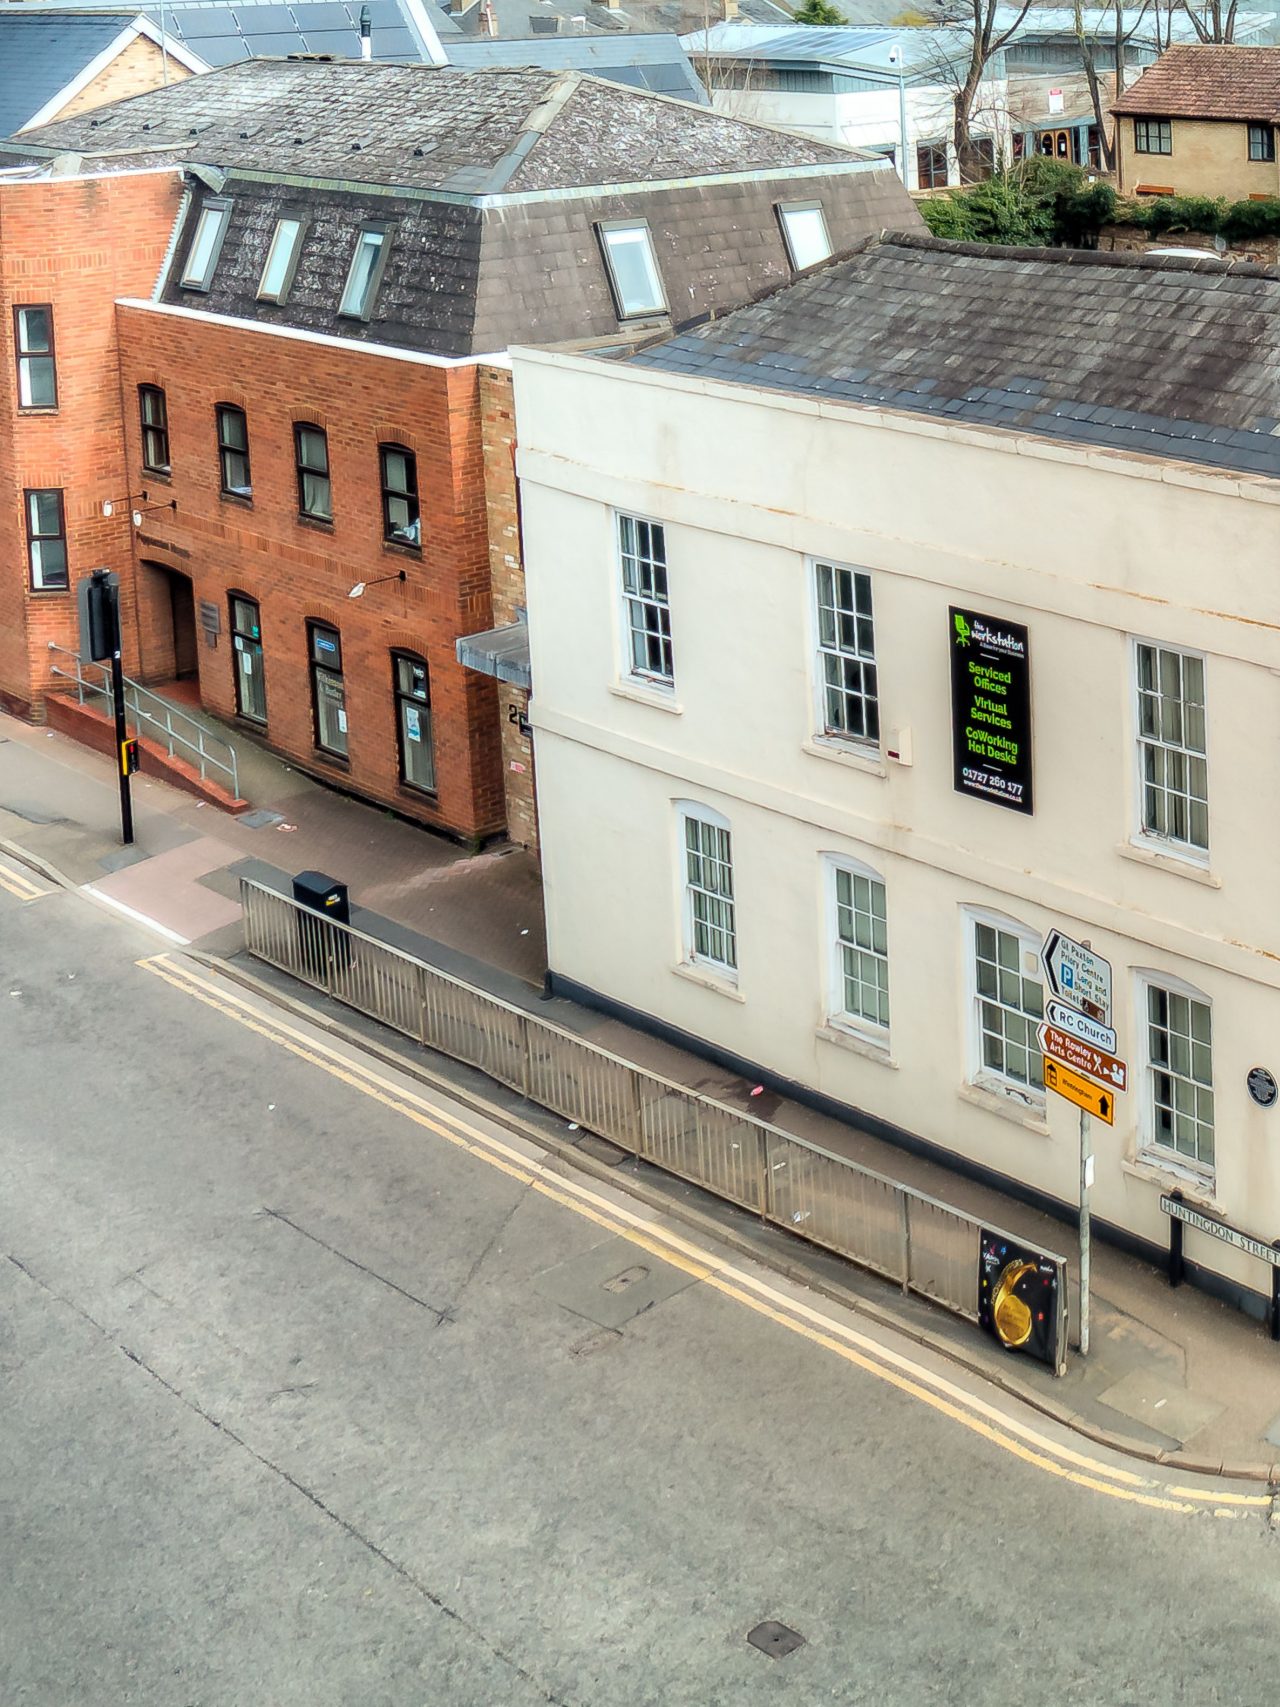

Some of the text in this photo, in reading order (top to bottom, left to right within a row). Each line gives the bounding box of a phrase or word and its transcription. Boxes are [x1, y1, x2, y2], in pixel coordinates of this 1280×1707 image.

[971, 627, 1024, 652] workstation
[968, 661, 1011, 684] Serviced
[974, 675, 1007, 695] Offices
[970, 707, 1012, 729] Services
[974, 694, 1008, 715] Virtual
[966, 726, 1018, 755] CoWorking
[968, 740, 1017, 765] Hot Desks
[962, 767, 989, 785] 01727
[1007, 781, 1023, 796] 177
[1061, 951, 1104, 984] Priory Centre
[1071, 945, 1095, 966] Paxton
[1074, 981, 1109, 1011] Short Stay
[1076, 971, 1093, 989] Long
[1094, 984, 1107, 997] and
[1059, 1011, 1112, 1045] RC Church
[1050, 1029, 1092, 1060] The Rowley
[1050, 1041, 1093, 1070] Arts Centre
[1163, 1200, 1280, 1264] HUNTINGDON STREET
